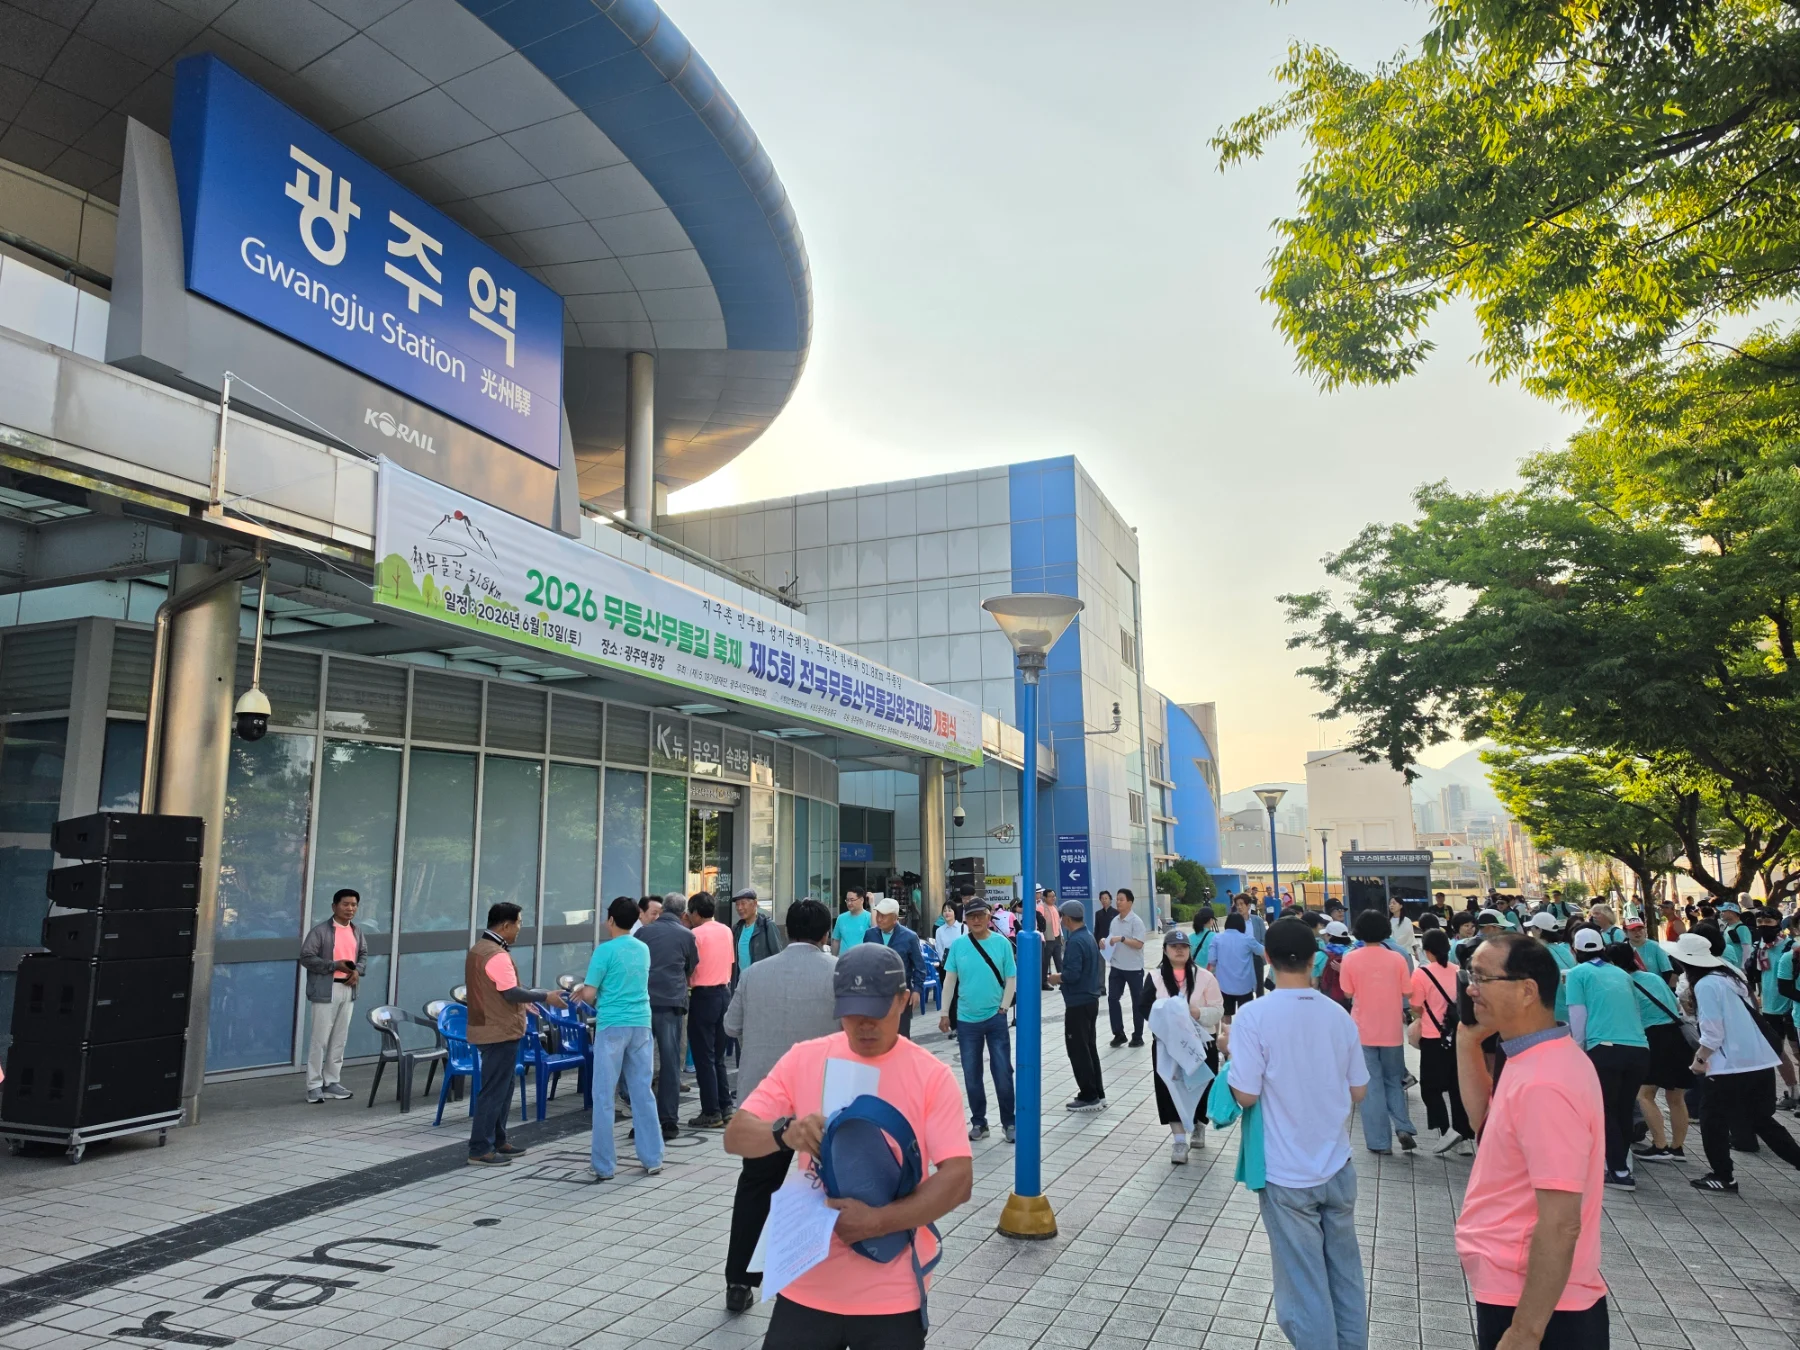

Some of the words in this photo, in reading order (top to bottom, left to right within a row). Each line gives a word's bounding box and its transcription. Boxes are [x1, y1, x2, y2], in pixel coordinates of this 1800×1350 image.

[285, 144, 517, 369] 광주역
[240, 236, 375, 335] Gwangju
[380, 312, 466, 383] Station
[480, 367, 532, 418] 光州驛
[364, 407, 437, 455] KORAIL
[427, 552, 464, 582] 무돌길
[444, 590, 469, 615] 일정
[477, 603, 520, 630] 2026년
[522, 615, 540, 636] 6월
[542, 622, 582, 646] 13일(토)
[525, 568, 598, 623] 2026
[604, 594, 710, 660] 무등산무돌길
[713, 631, 743, 669] 축제
[747, 640, 796, 689] 제5회
[798, 659, 933, 733] 전국무등산무돌길완주대회
[933, 709, 957, 742] 개회식
[601, 638, 618, 656] 장소
[624, 645, 649, 666] 광주역
[649, 652, 666, 671] 광장
[702, 598, 733, 625] 지구촌
[737, 612, 766, 636] 민주화
[816, 643, 838, 665] 무등산
[886, 671, 902, 690] 무돌길
[1060, 854, 1087, 864] 무등산실
[1353, 854, 1431, 862] 북구스마트도서관(광주역)
